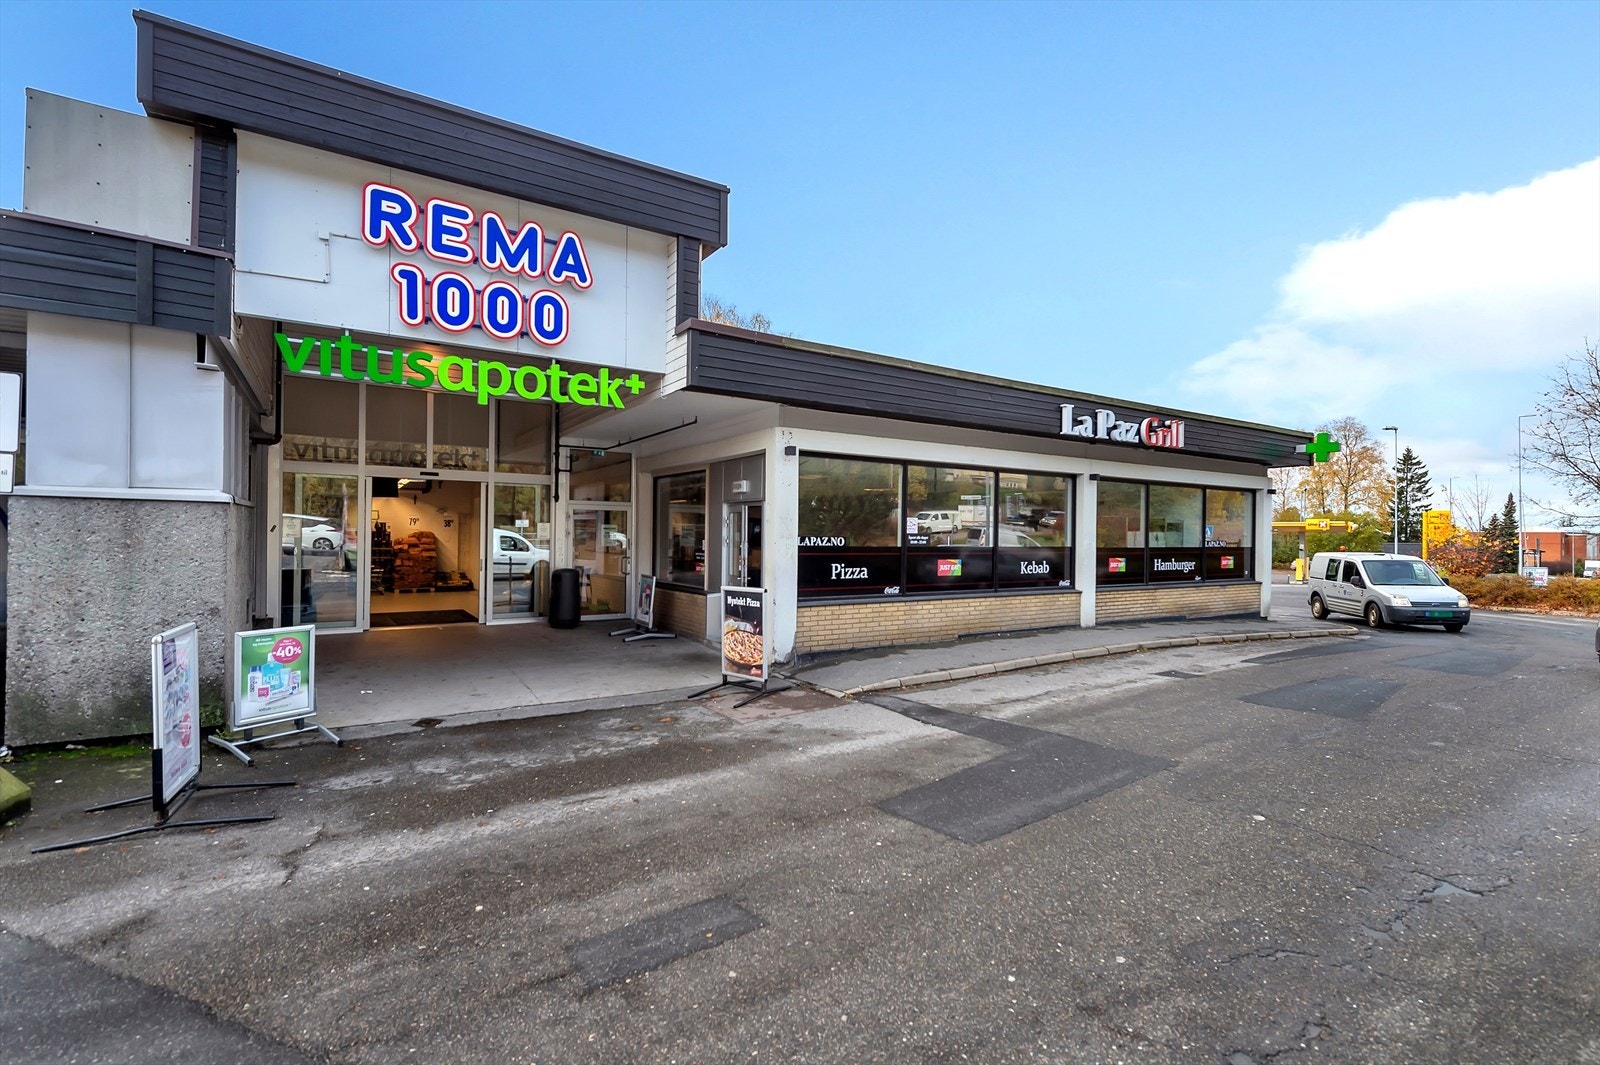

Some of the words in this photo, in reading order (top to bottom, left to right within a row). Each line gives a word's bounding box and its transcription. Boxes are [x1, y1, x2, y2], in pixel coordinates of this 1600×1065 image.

[361, 181, 593, 291] REMA
[390, 262, 570, 347] 1000
[1060, 403, 1094, 438] La
[1095, 408, 1140, 443] Paz
[1140, 416, 1185, 449] Grill
[797, 536, 846, 547] LAPAZ.NO
[831, 563, 868, 580] Pizza
[1020, 560, 1050, 575] Kebab
[1153, 558, 1196, 573] Hamburger
[272, 645, 302, 658] -40%
